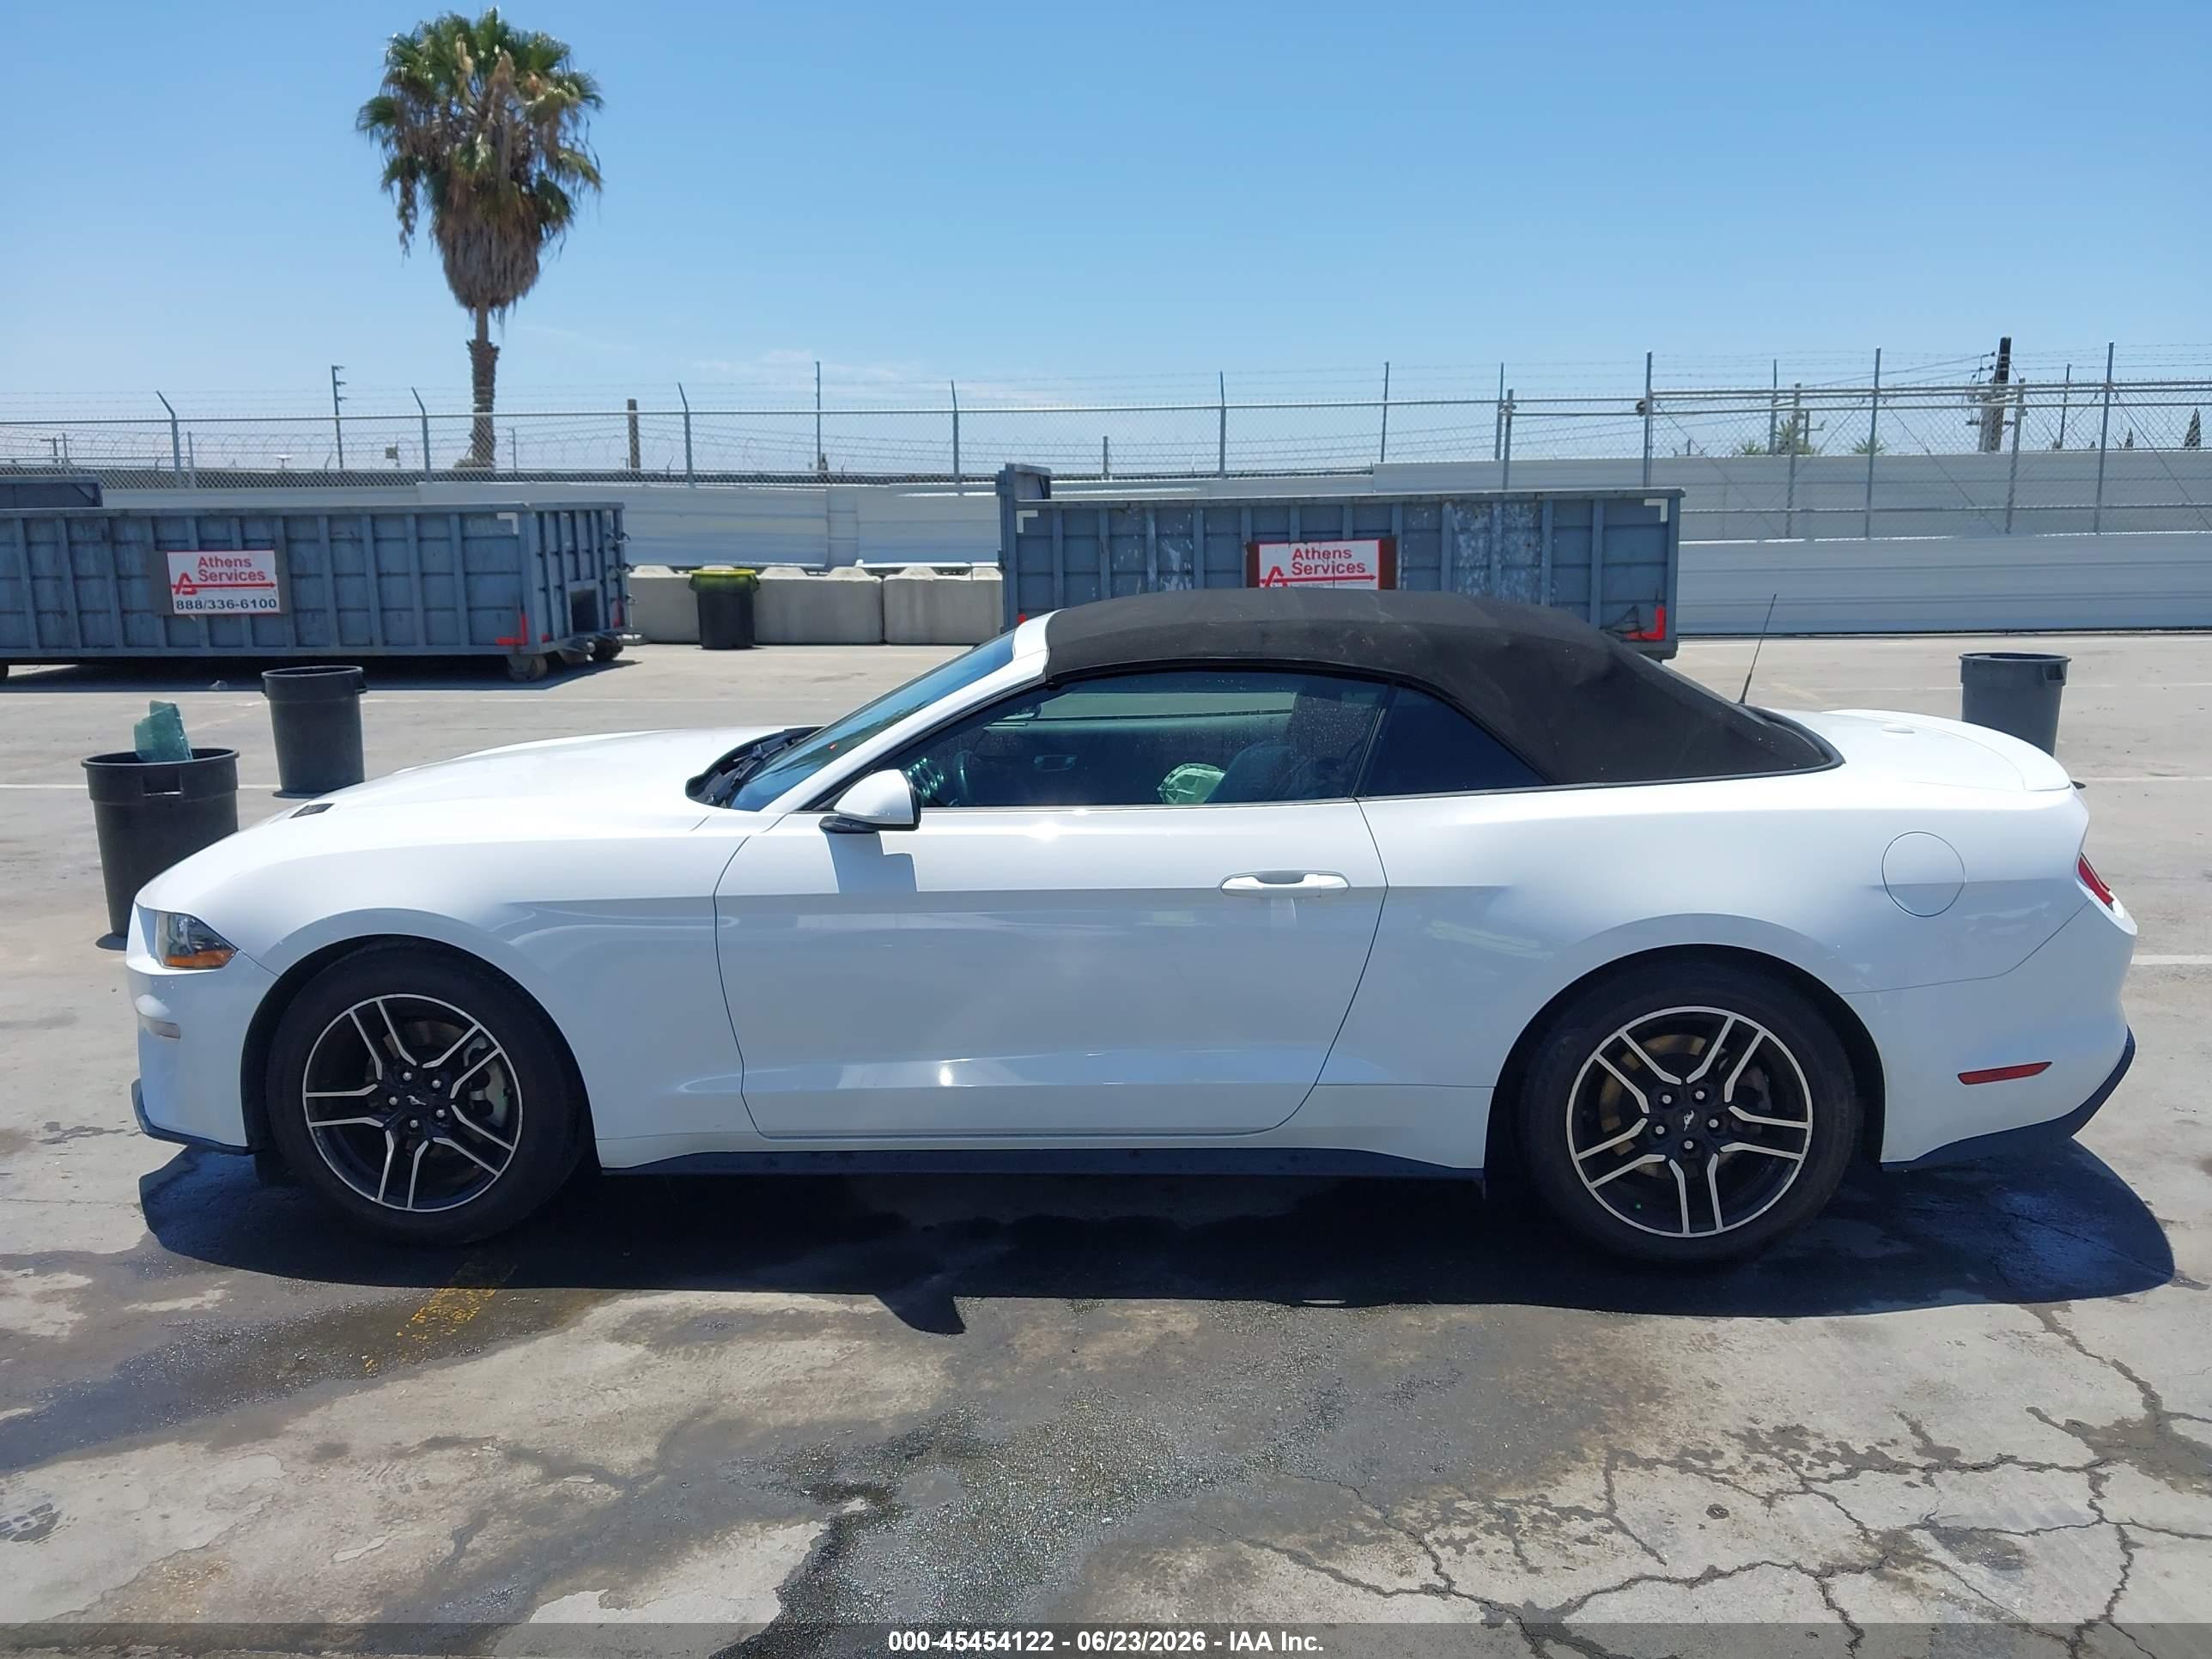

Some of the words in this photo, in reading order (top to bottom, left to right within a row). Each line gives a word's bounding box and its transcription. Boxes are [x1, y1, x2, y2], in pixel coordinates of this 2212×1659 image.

[1292, 547, 1352, 561] Athens
[198, 556, 252, 568] Athens
[1291, 561, 1365, 575] Services
[198, 568, 266, 582] Services
[176, 599, 276, 610] 888/336-6100
